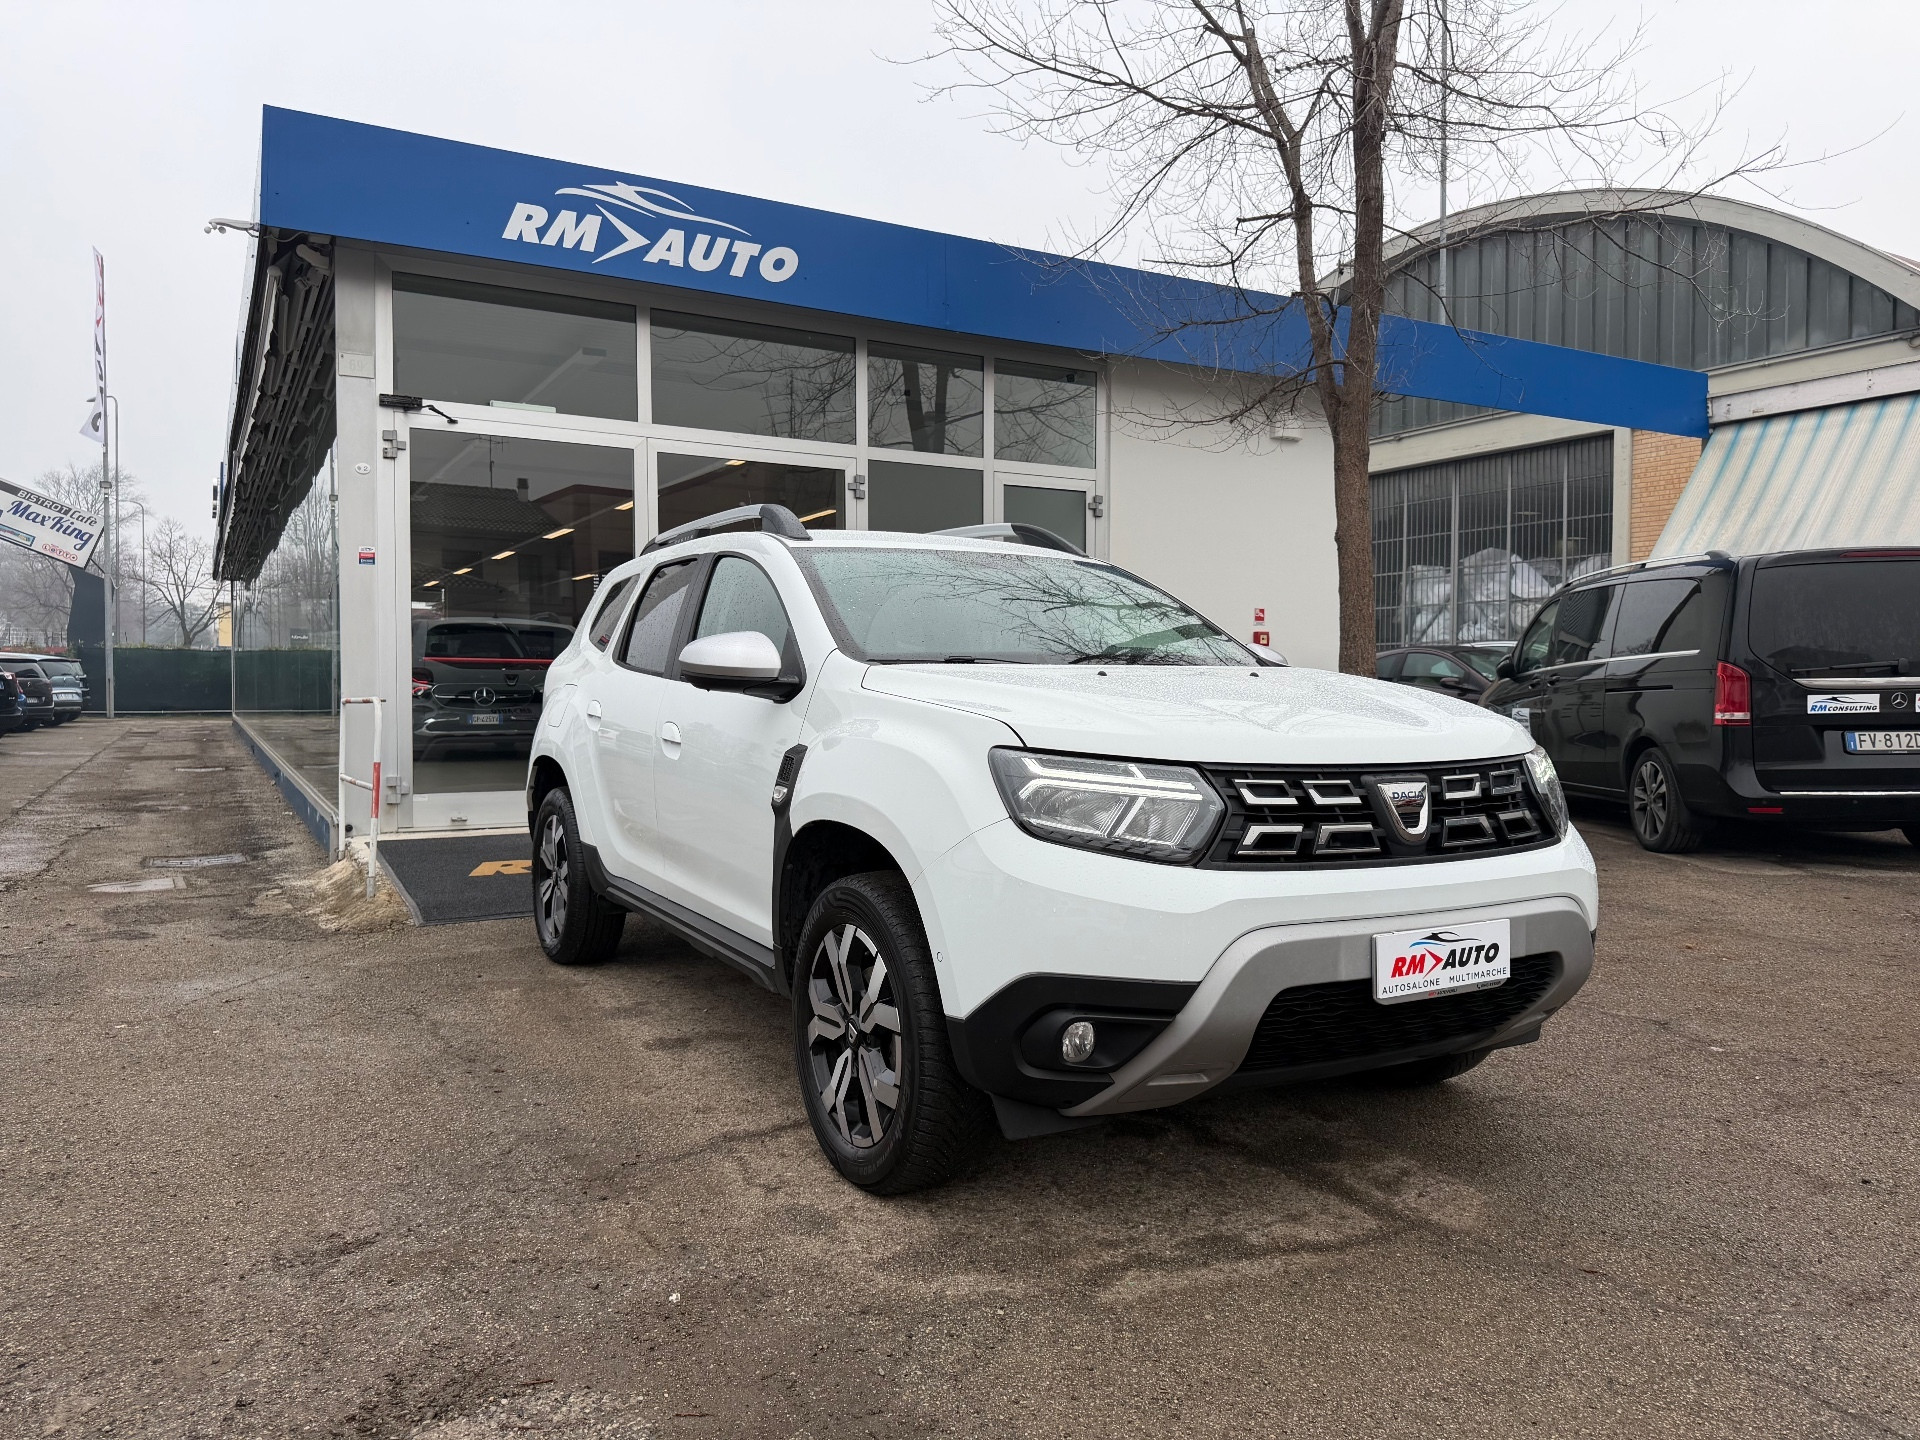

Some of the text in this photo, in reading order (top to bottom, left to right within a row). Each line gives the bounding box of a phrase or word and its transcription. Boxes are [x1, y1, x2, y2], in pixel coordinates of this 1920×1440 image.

[643, 229, 799, 283] AUTO
[17, 490, 69, 514] BISTROT
[1392, 791, 1424, 799] DACIA
[1441, 942, 1500, 970] AUTO
[1382, 978, 1441, 995] AUTOSALONE
[1449, 967, 1508, 984] MULTIMARCHE
